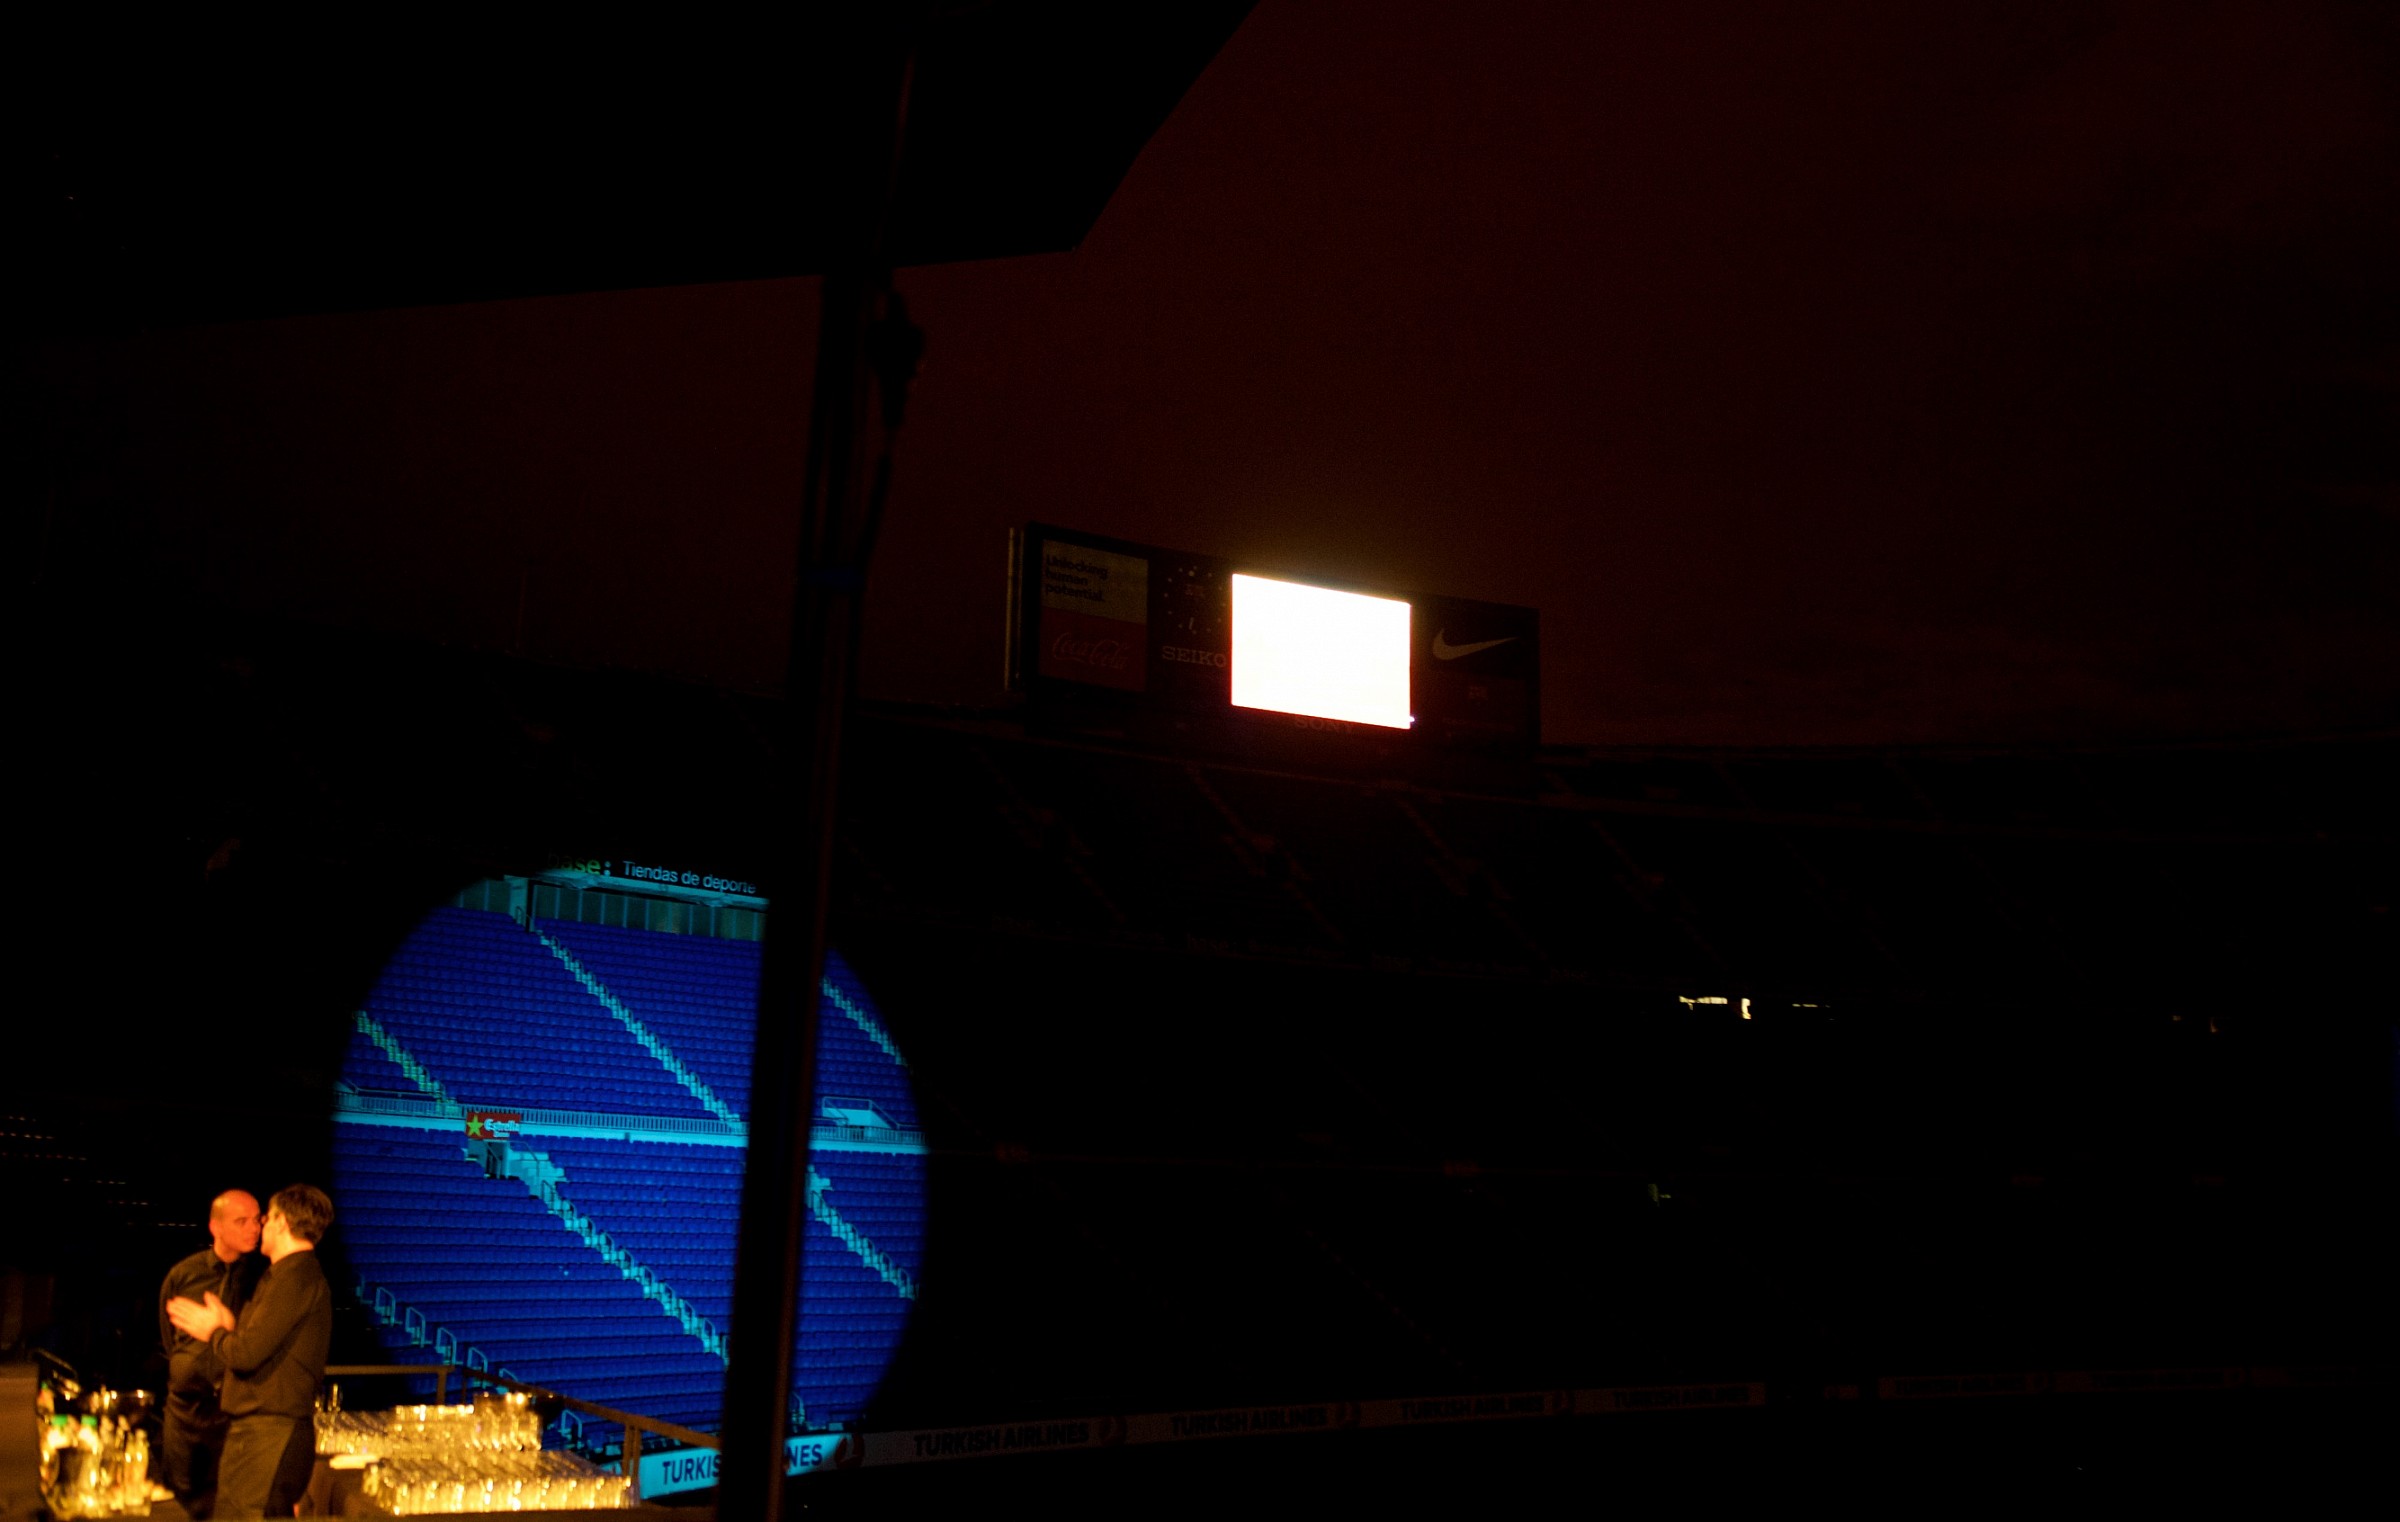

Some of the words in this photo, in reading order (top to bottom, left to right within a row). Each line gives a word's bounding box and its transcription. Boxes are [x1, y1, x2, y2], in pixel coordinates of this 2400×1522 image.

[1045, 568, 1088, 586] human
[1160, 644, 1228, 669] SEIKO
[622, 859, 679, 884] Tiendas
[680, 869, 701, 886] de
[1171, 1411, 1248, 1437] TURKISH
[1251, 1405, 1327, 1431] AIRLINES
[913, 1430, 999, 1457] TURKISH
[1003, 1422, 1090, 1450] AIRLINES
